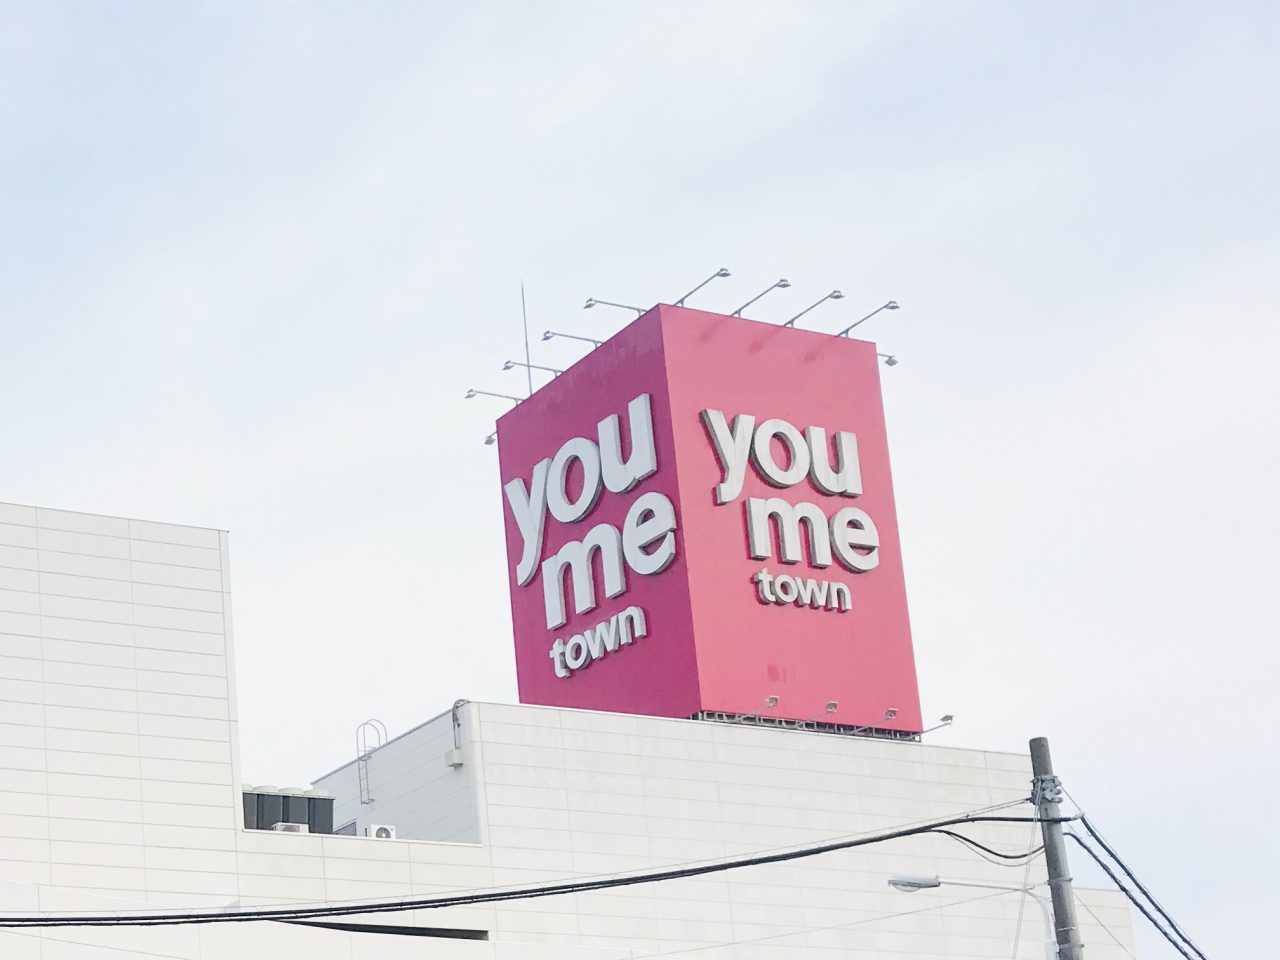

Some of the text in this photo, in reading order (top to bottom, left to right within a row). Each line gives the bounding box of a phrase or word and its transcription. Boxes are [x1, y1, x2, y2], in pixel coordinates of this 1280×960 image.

[503, 393, 658, 586] you
[699, 407, 863, 504] you
[541, 490, 677, 631] me
[745, 496, 880, 573] me
[754, 567, 853, 612] town
[549, 604, 647, 678] town
